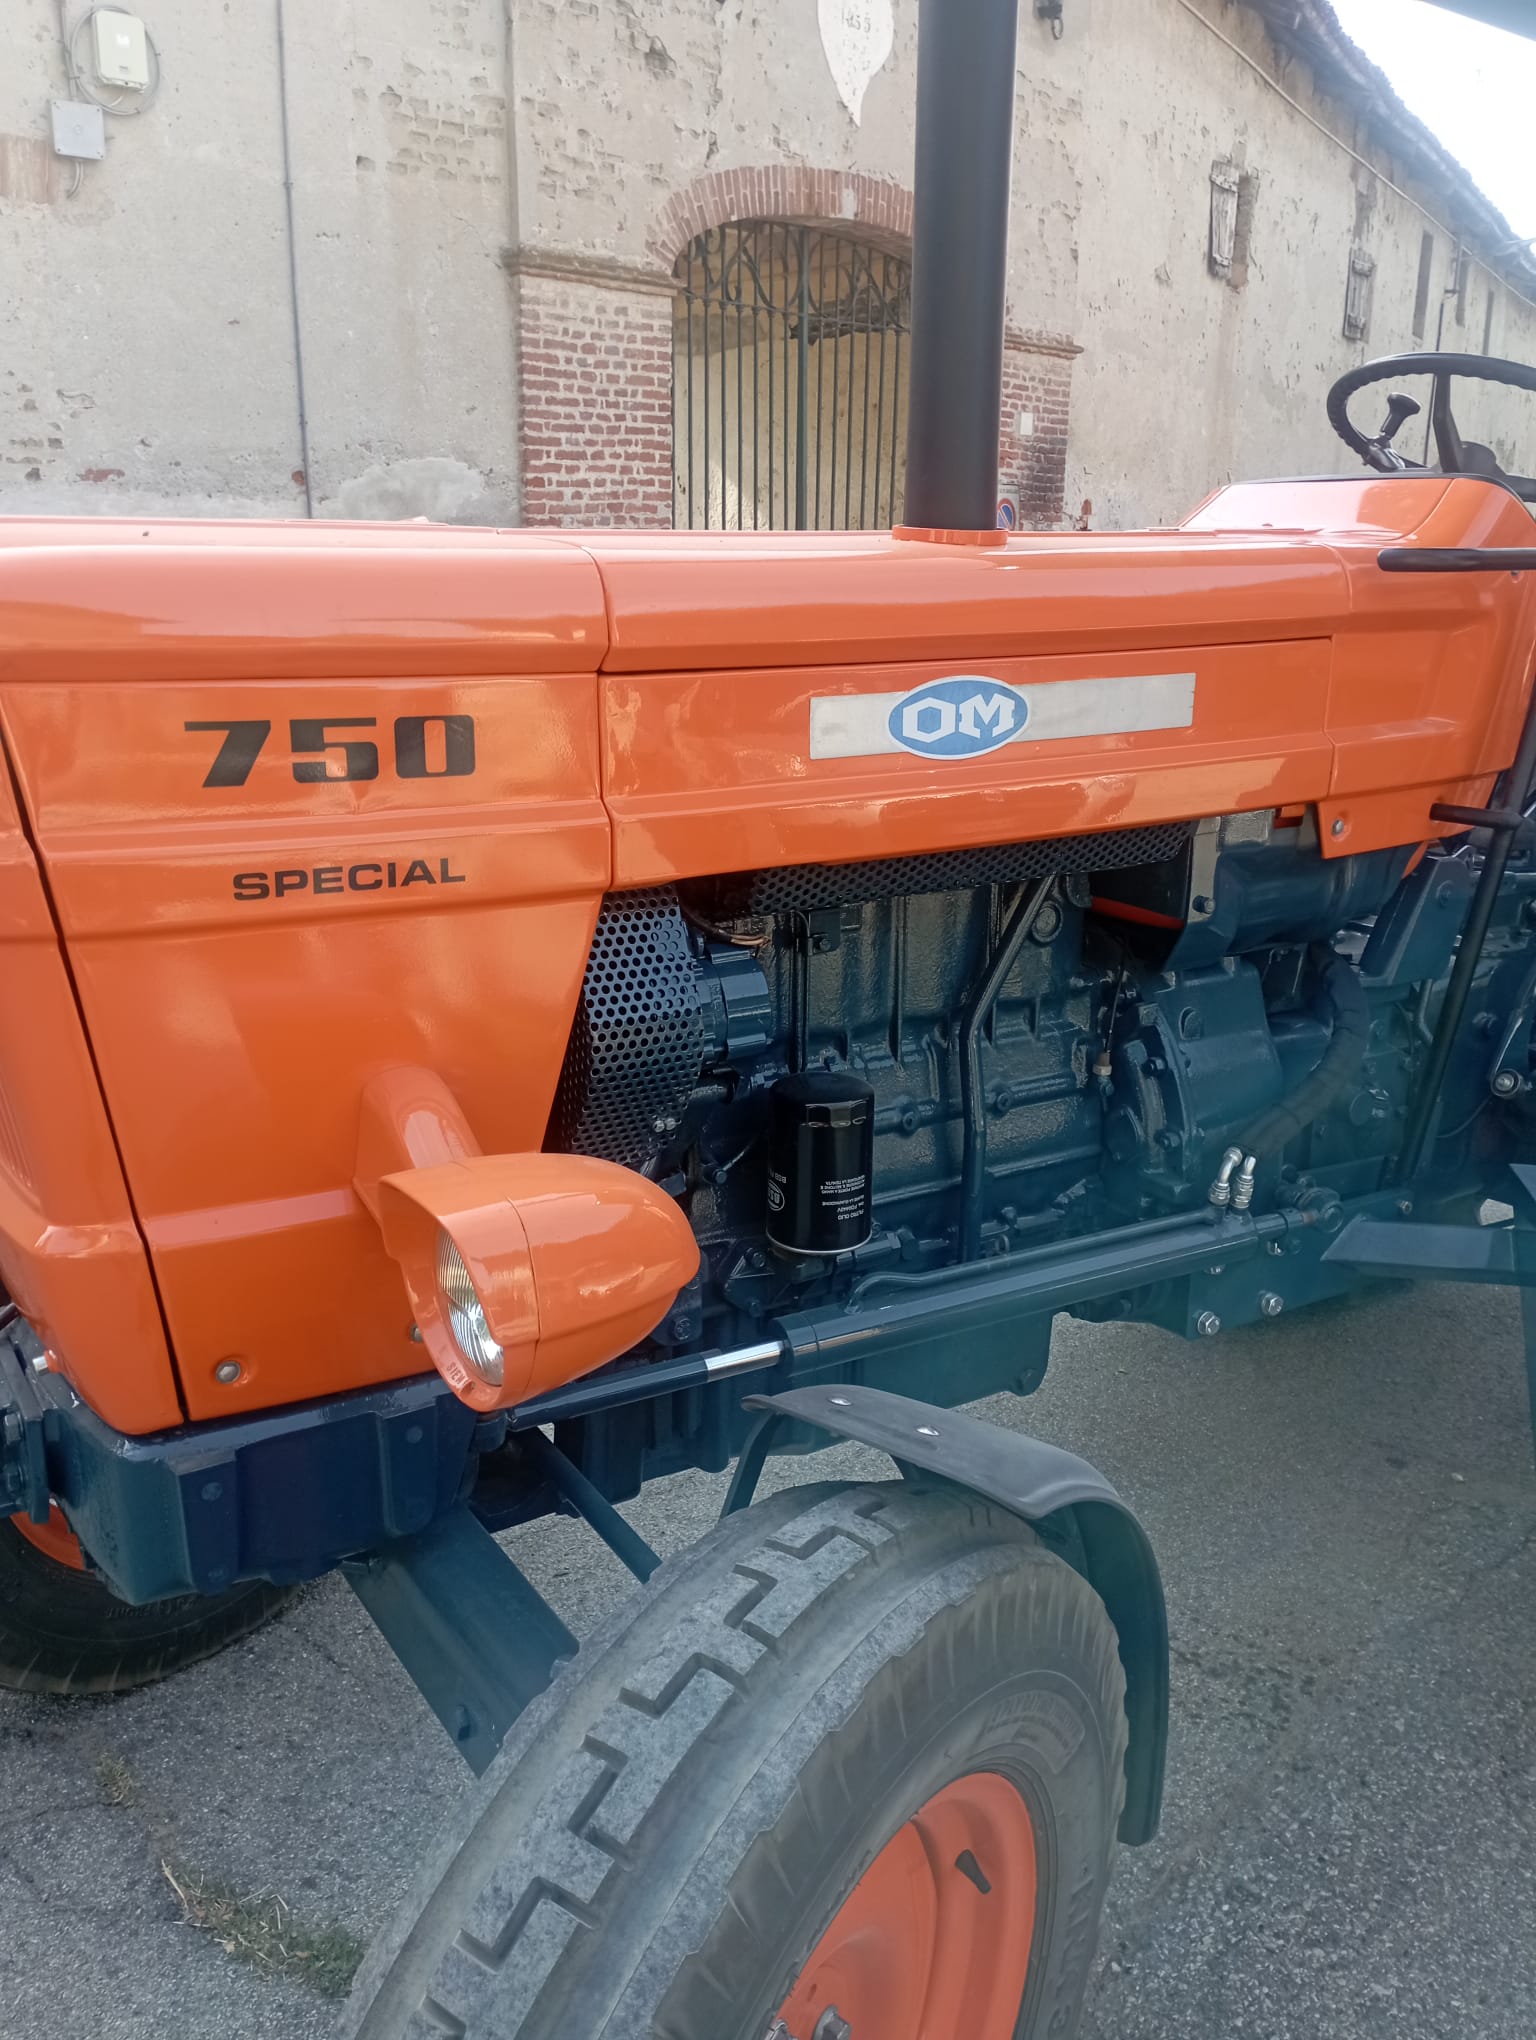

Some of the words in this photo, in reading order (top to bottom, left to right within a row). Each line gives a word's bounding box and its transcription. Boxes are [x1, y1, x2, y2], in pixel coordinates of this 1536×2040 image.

[902, 692, 1016, 743] OM
[184, 714, 476, 788] 750
[233, 857, 465, 901] SPECIAL
